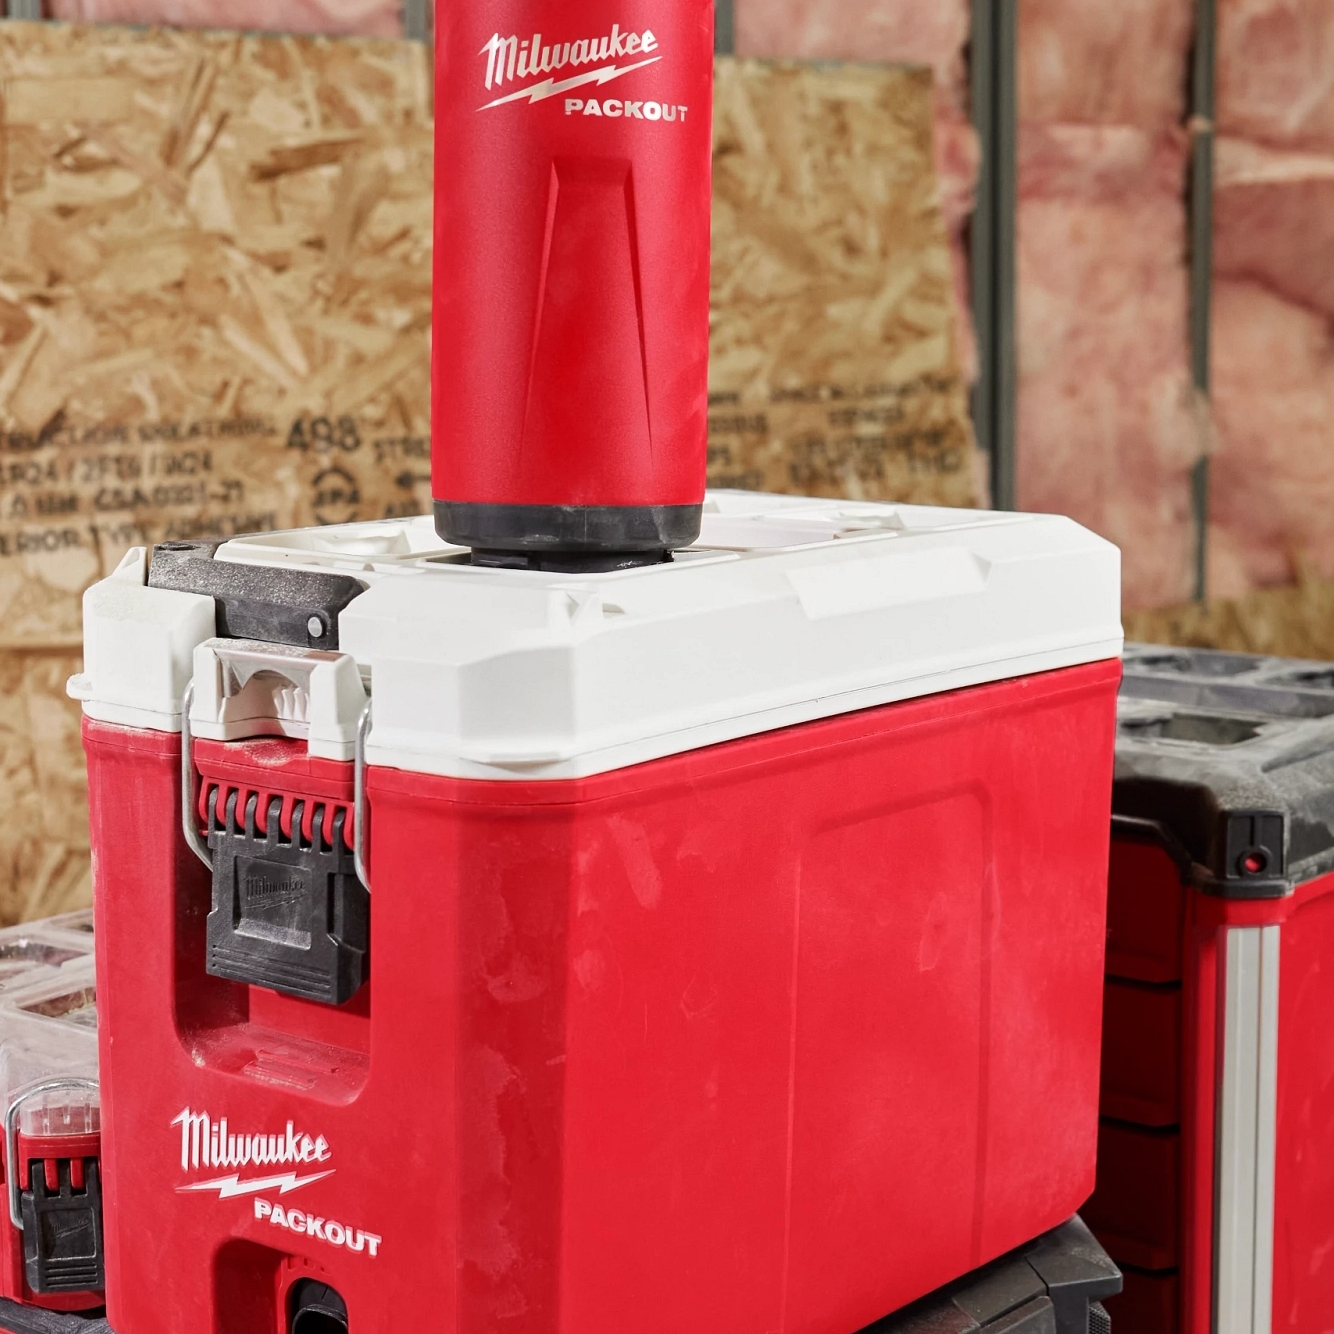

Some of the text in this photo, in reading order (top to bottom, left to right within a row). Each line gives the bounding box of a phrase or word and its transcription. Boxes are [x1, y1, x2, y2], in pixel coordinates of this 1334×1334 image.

[478, 23, 659, 91] Milwaukee
[563, 97, 689, 123] PACKOUT
[169, 1105, 333, 1173] Milwaukee
[253, 1196, 383, 1260] PACKOUT
